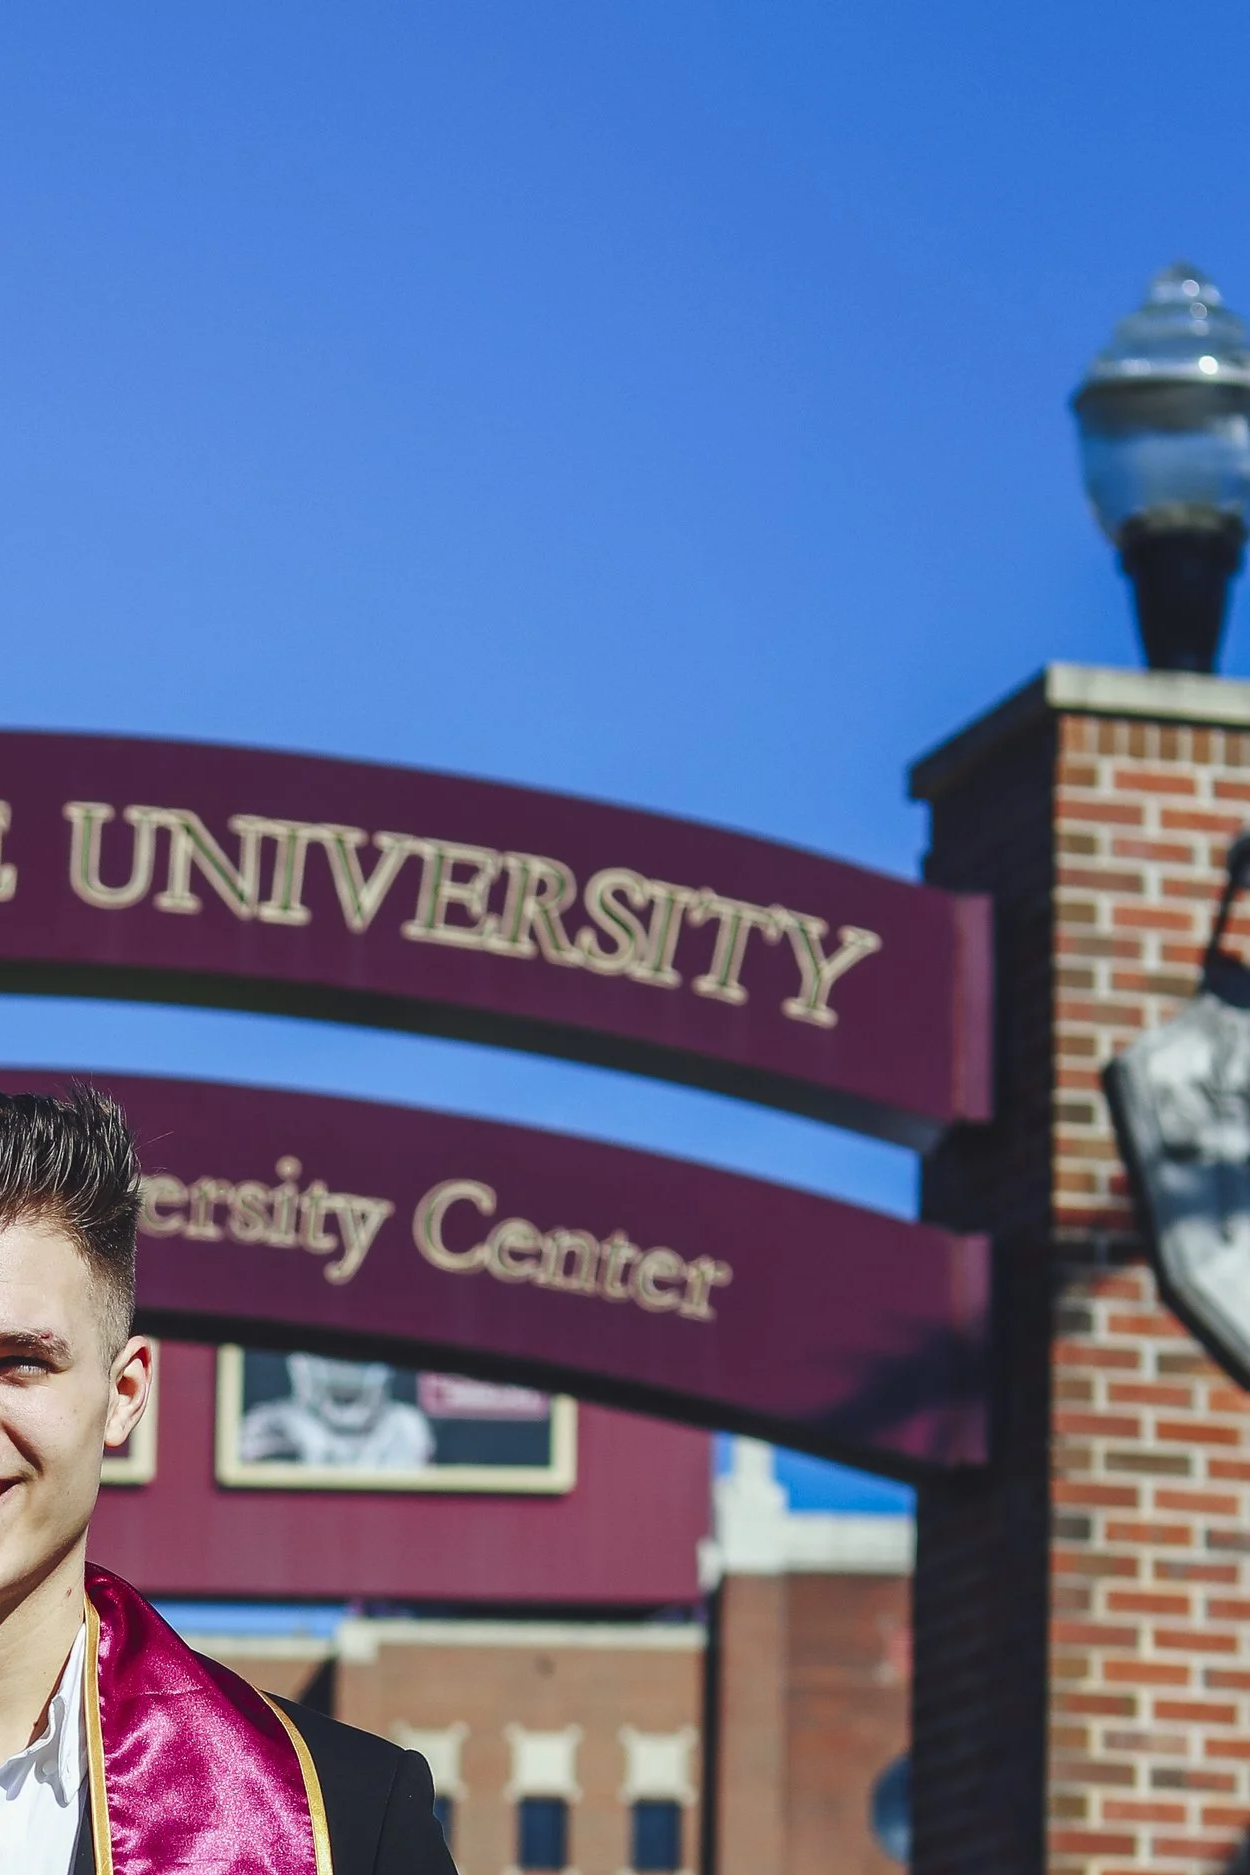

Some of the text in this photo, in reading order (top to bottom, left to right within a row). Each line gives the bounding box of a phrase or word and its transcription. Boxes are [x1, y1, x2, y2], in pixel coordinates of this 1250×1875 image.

[64, 802, 882, 1028] UNIVERSITY
[134, 1156, 394, 1284] ersity
[412, 1179, 732, 1319] Center
